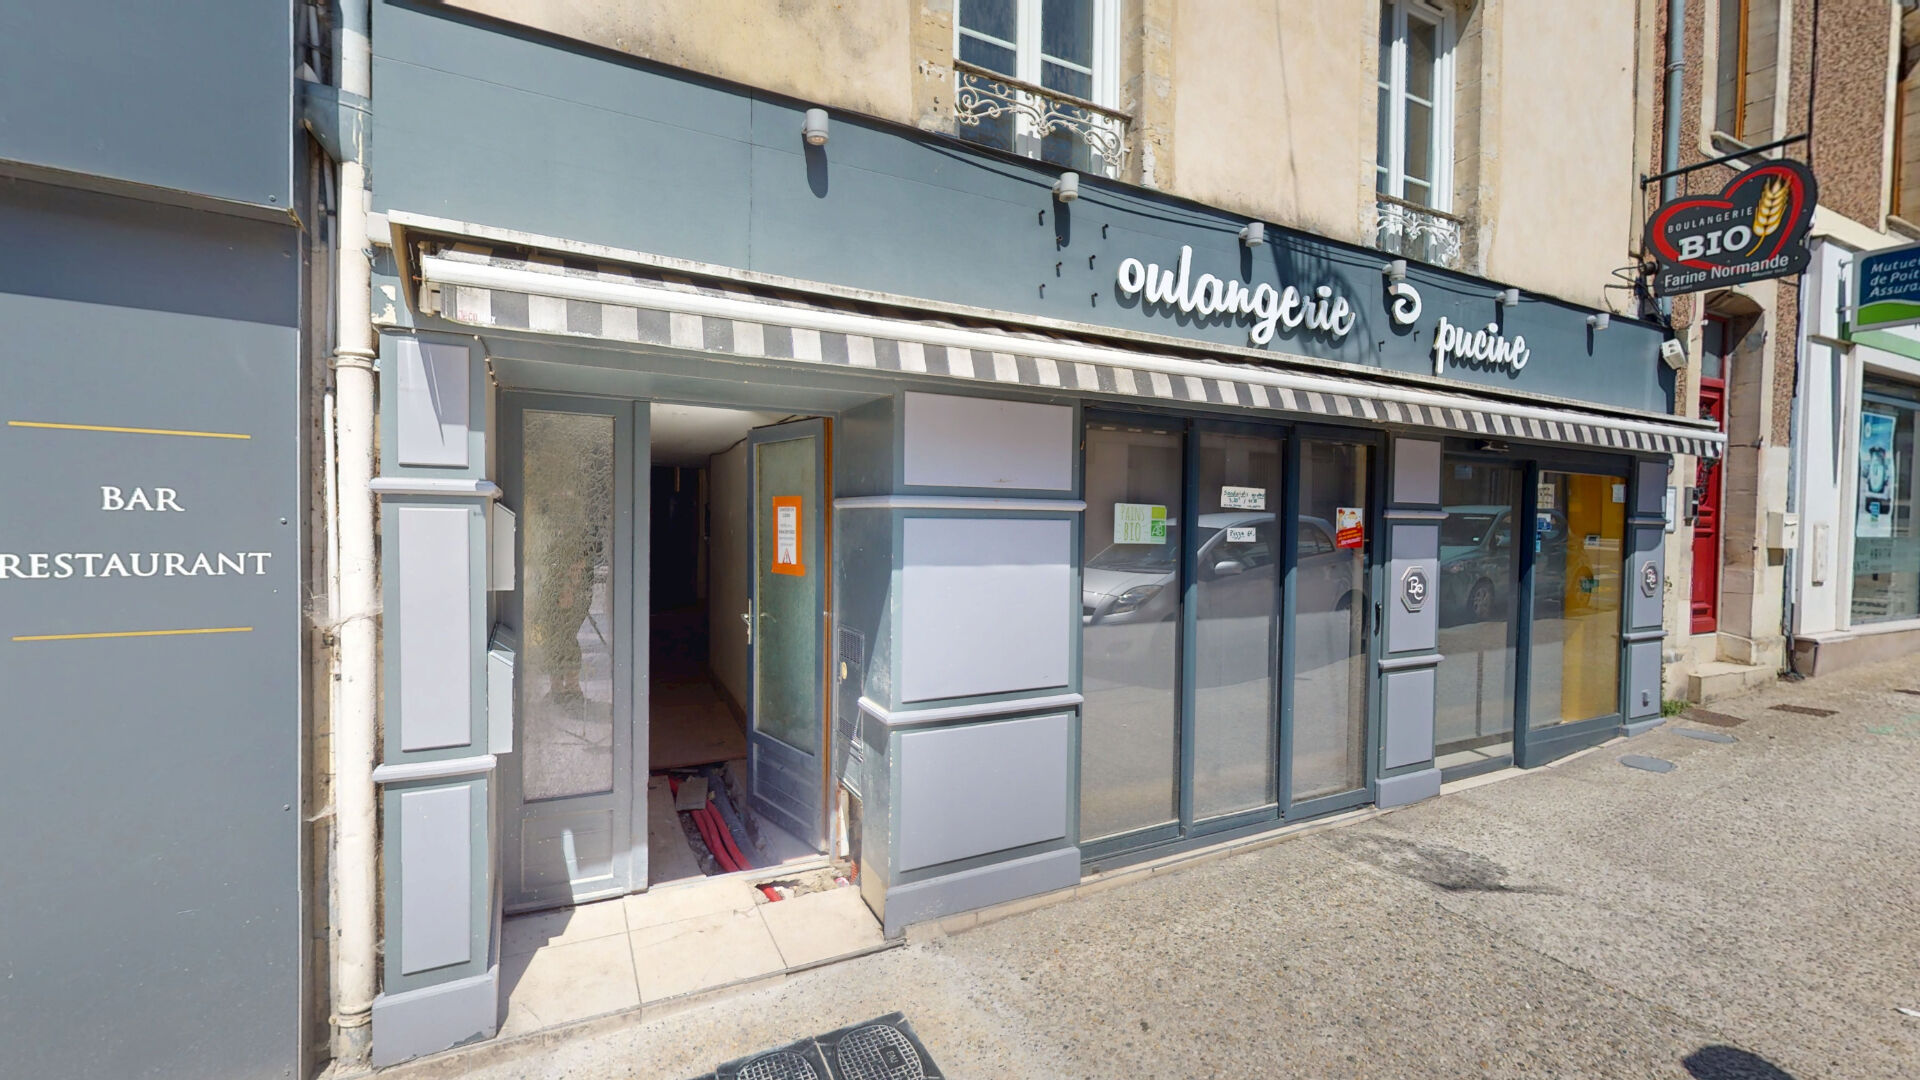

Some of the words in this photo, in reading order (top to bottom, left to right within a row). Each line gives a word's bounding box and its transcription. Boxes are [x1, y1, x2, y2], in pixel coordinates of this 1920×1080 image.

[1668, 207, 1753, 234] BOULANGERIE
[1678, 225, 1752, 261] BIO
[1664, 271, 1706, 288] Farine
[1711, 254, 1789, 279] Normande
[1870, 275, 1888, 287] de
[1117, 245, 1356, 345] oulangerie
[1433, 316, 1530, 374] pucine
[100, 486, 185, 512] BAR
[1120, 504, 1145, 521] PAINS
[1123, 521, 1142, 542] BIO
[0, 552, 272, 579] RESTAURANT
